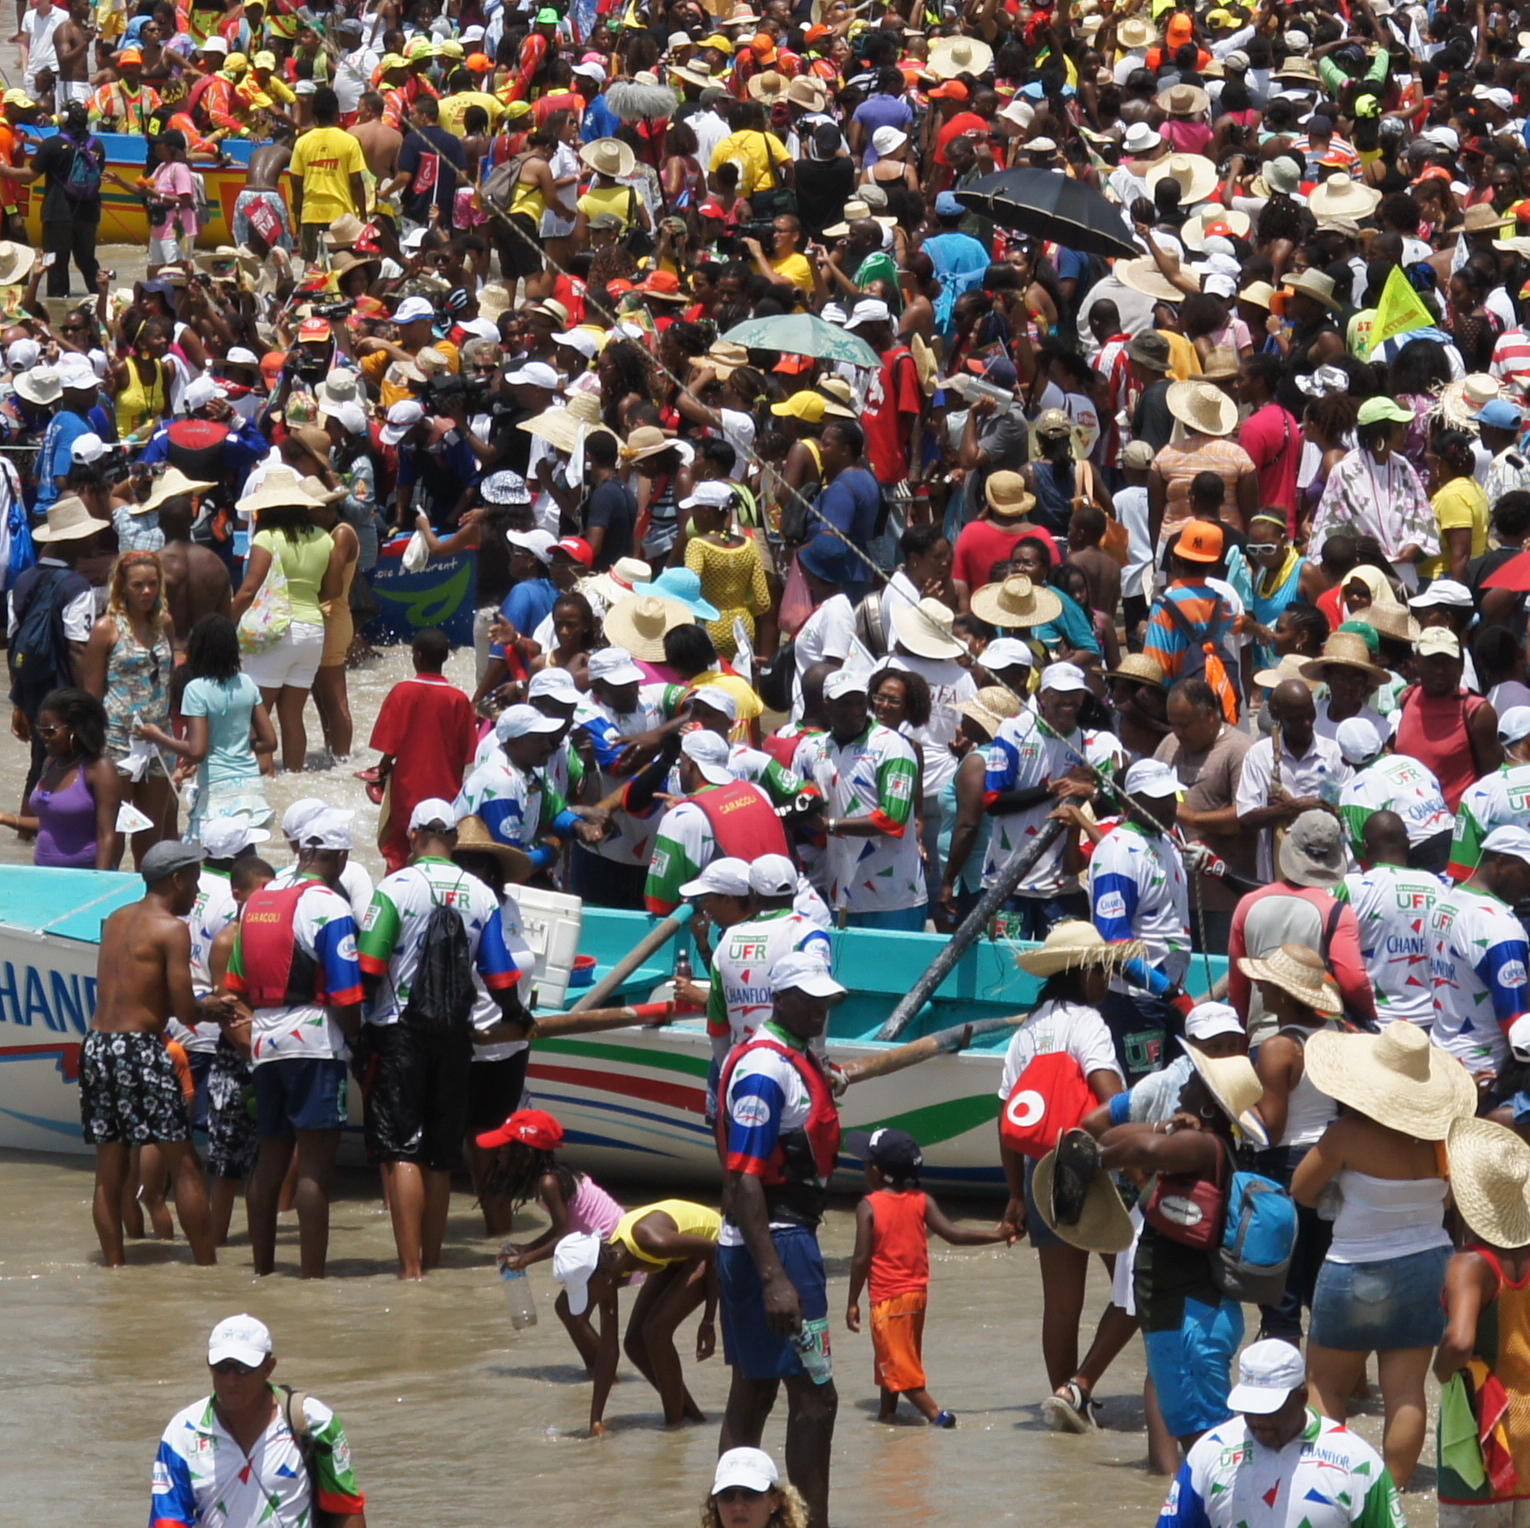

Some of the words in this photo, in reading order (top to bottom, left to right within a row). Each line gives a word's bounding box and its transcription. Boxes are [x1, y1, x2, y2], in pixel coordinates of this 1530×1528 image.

[1388, 767, 1423, 788] UFR
[718, 793, 758, 816] CARACOLI
[431, 891, 470, 909] UFR
[1396, 894, 1437, 911] UFR
[246, 912, 280, 924] CARACOLI
[1431, 912, 1454, 934] UFR
[729, 944, 768, 960] UFR
[1220, 1449, 1253, 1468] UFR
[1300, 1442, 1351, 1468] CHANFLOR
